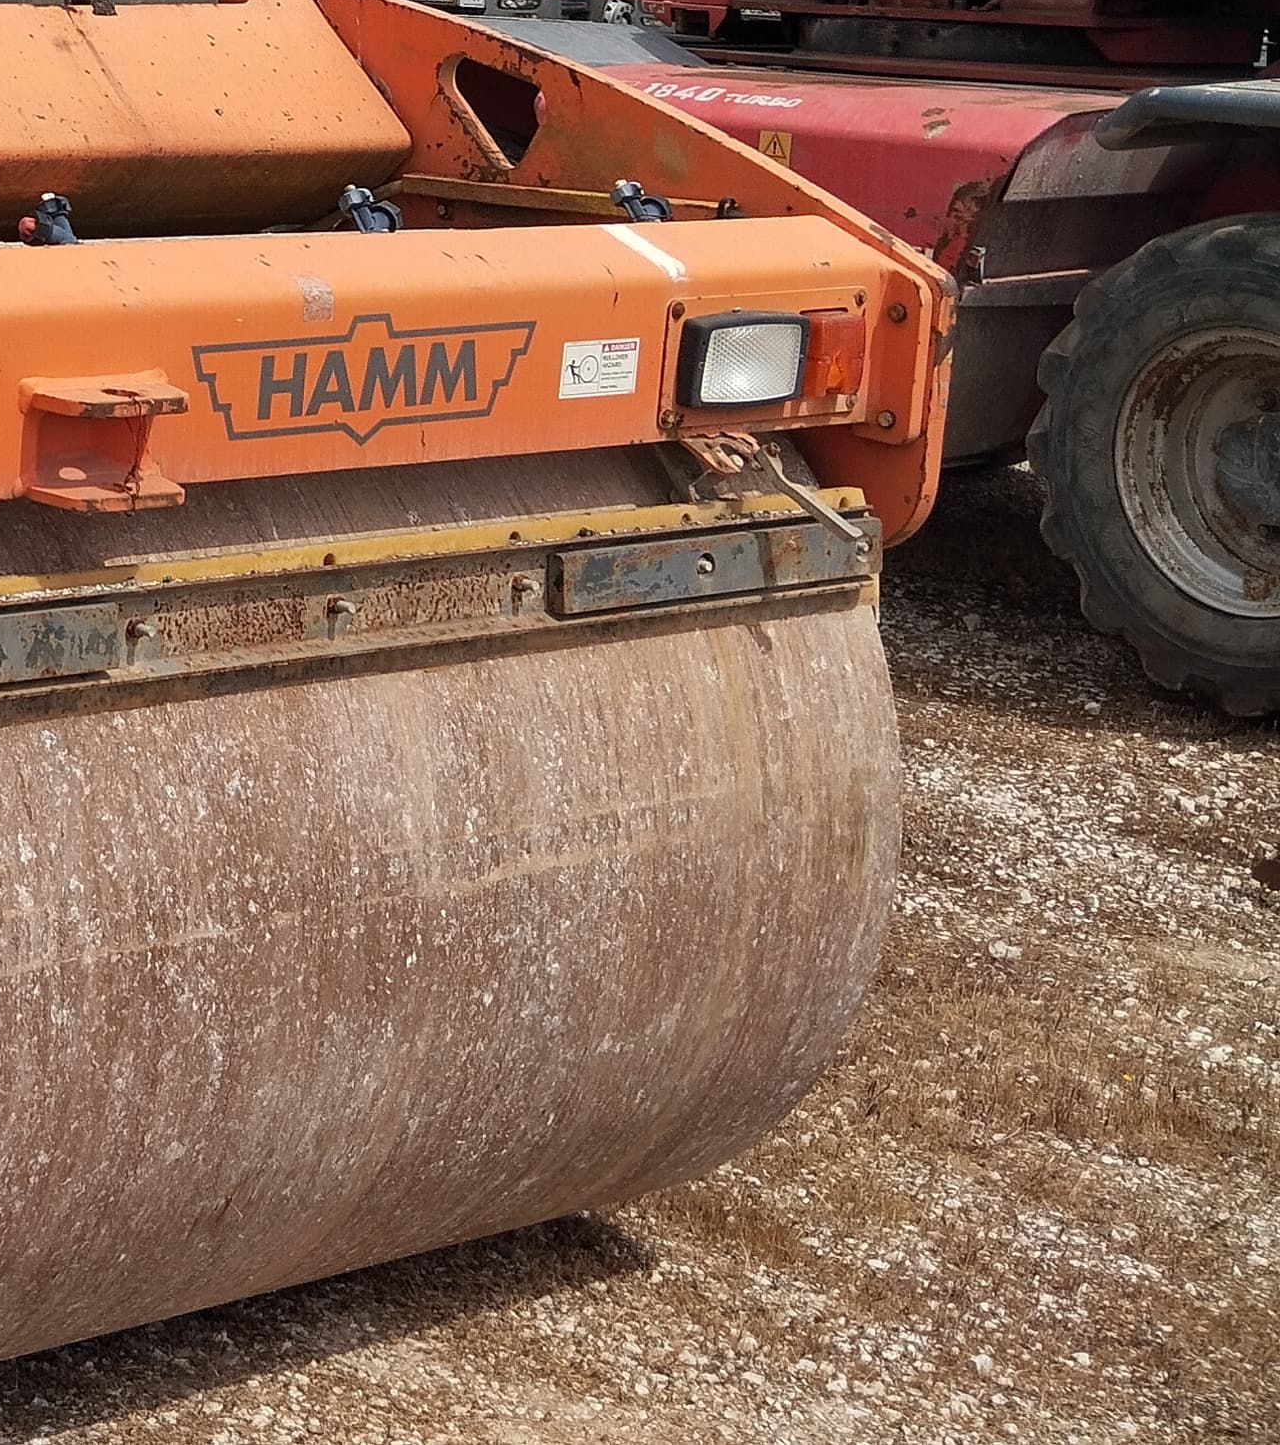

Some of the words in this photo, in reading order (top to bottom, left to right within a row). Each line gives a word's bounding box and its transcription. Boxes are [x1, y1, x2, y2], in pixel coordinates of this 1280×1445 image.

[643, 82, 728, 102] 1840
[724, 92, 803, 108] TURBO
[256, 338, 478, 421] HAMM
